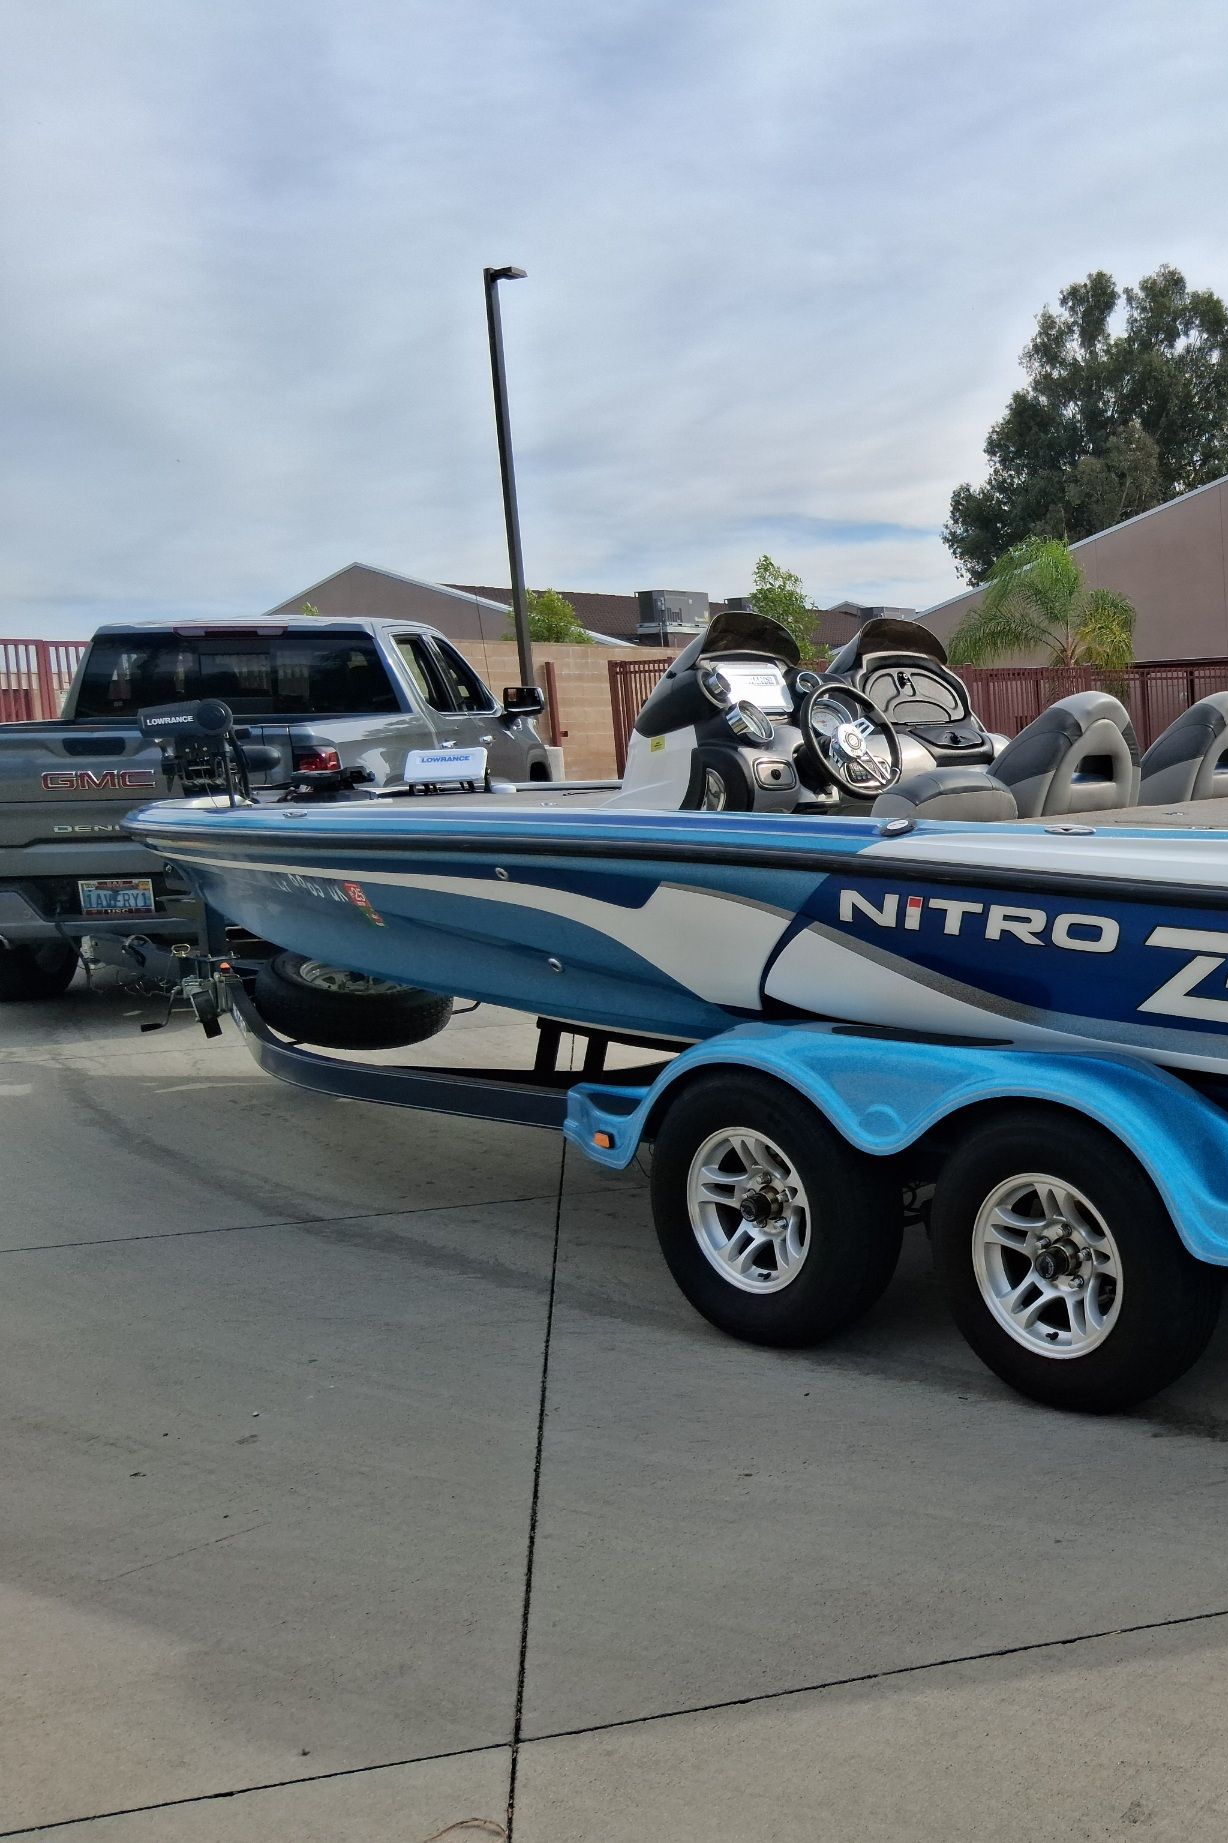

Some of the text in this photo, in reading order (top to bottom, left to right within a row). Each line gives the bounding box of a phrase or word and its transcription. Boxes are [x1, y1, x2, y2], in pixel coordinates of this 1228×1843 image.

[146, 715, 194, 726] LOWRANCE
[421, 755, 471, 763] LOWRANCE
[41, 770, 156, 791] GMC
